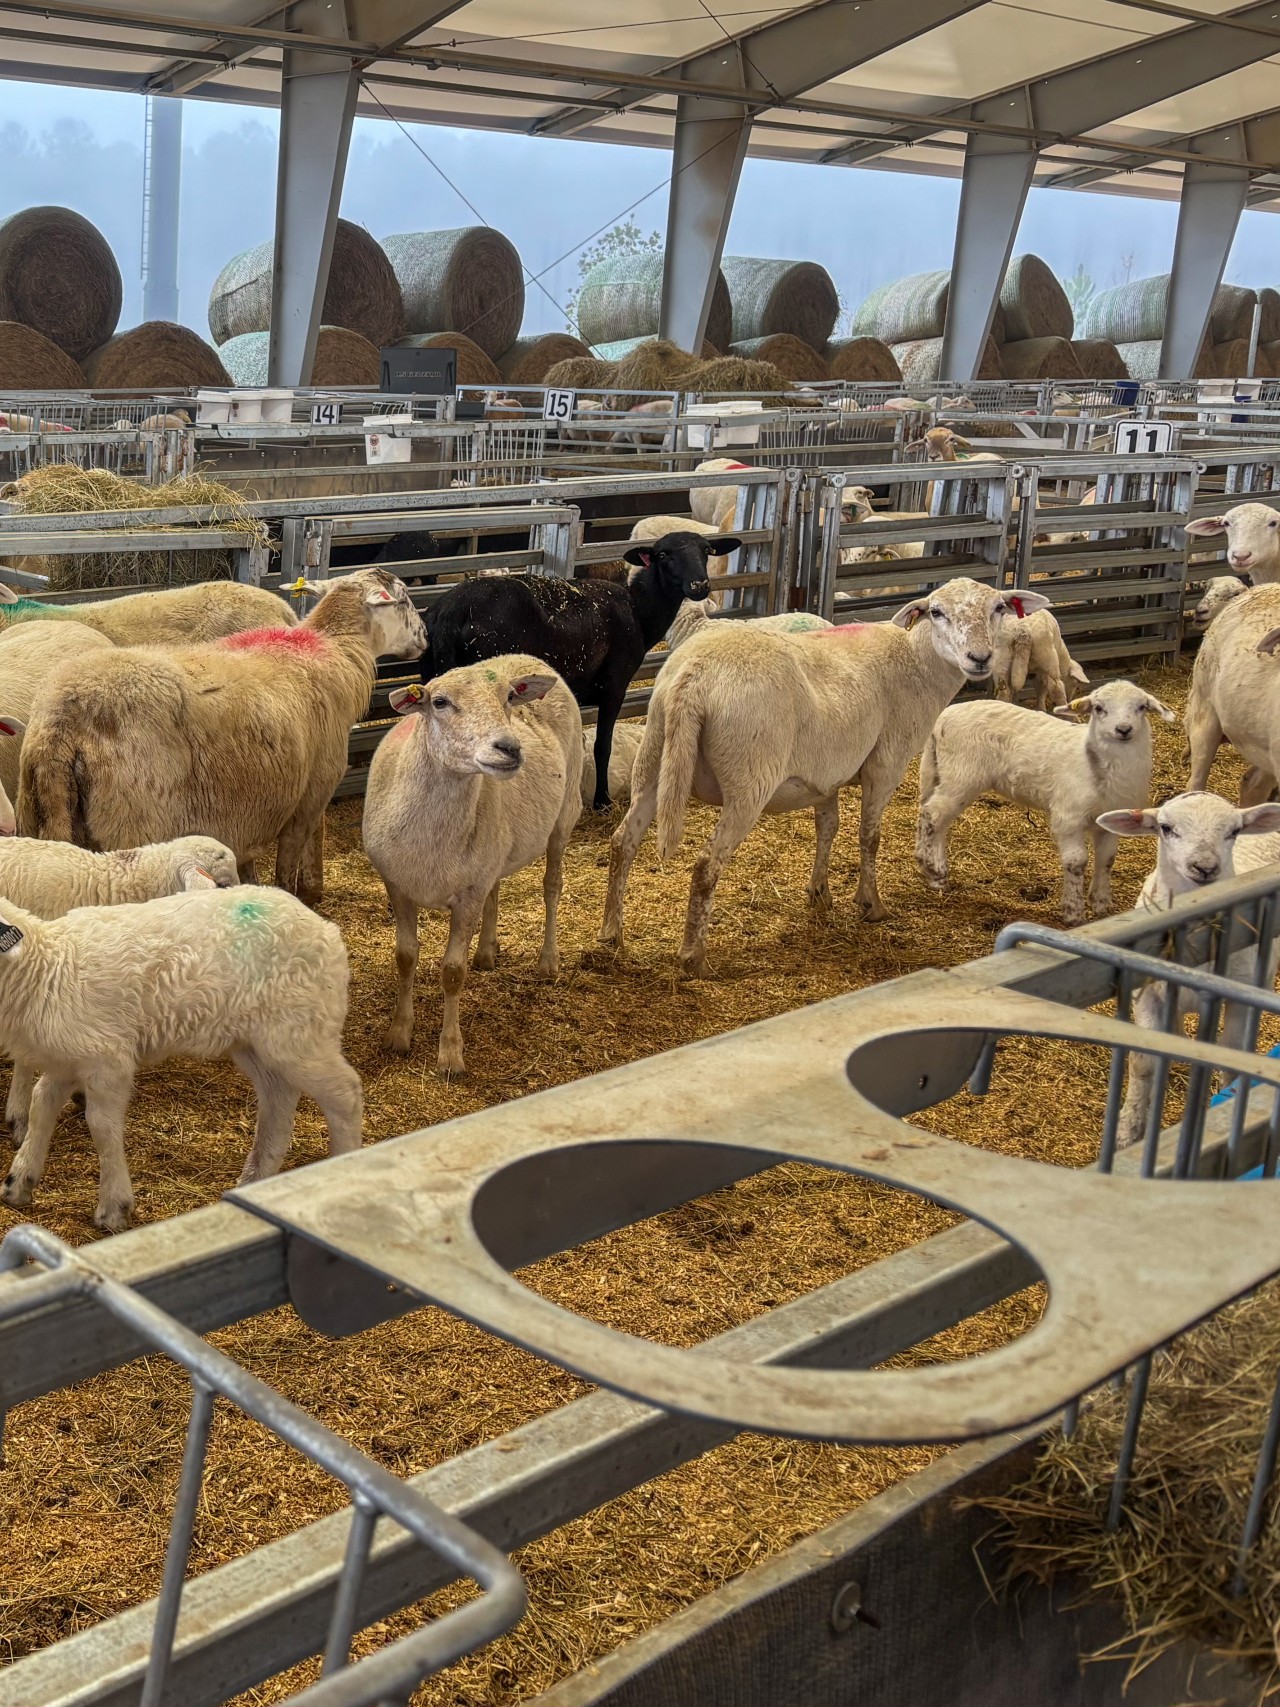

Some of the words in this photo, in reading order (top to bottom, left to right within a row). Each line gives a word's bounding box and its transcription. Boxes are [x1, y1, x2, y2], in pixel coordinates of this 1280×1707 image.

[315, 404, 335, 424] 14
[548, 393, 569, 418] 15
[1126, 429, 1158, 453] 11
